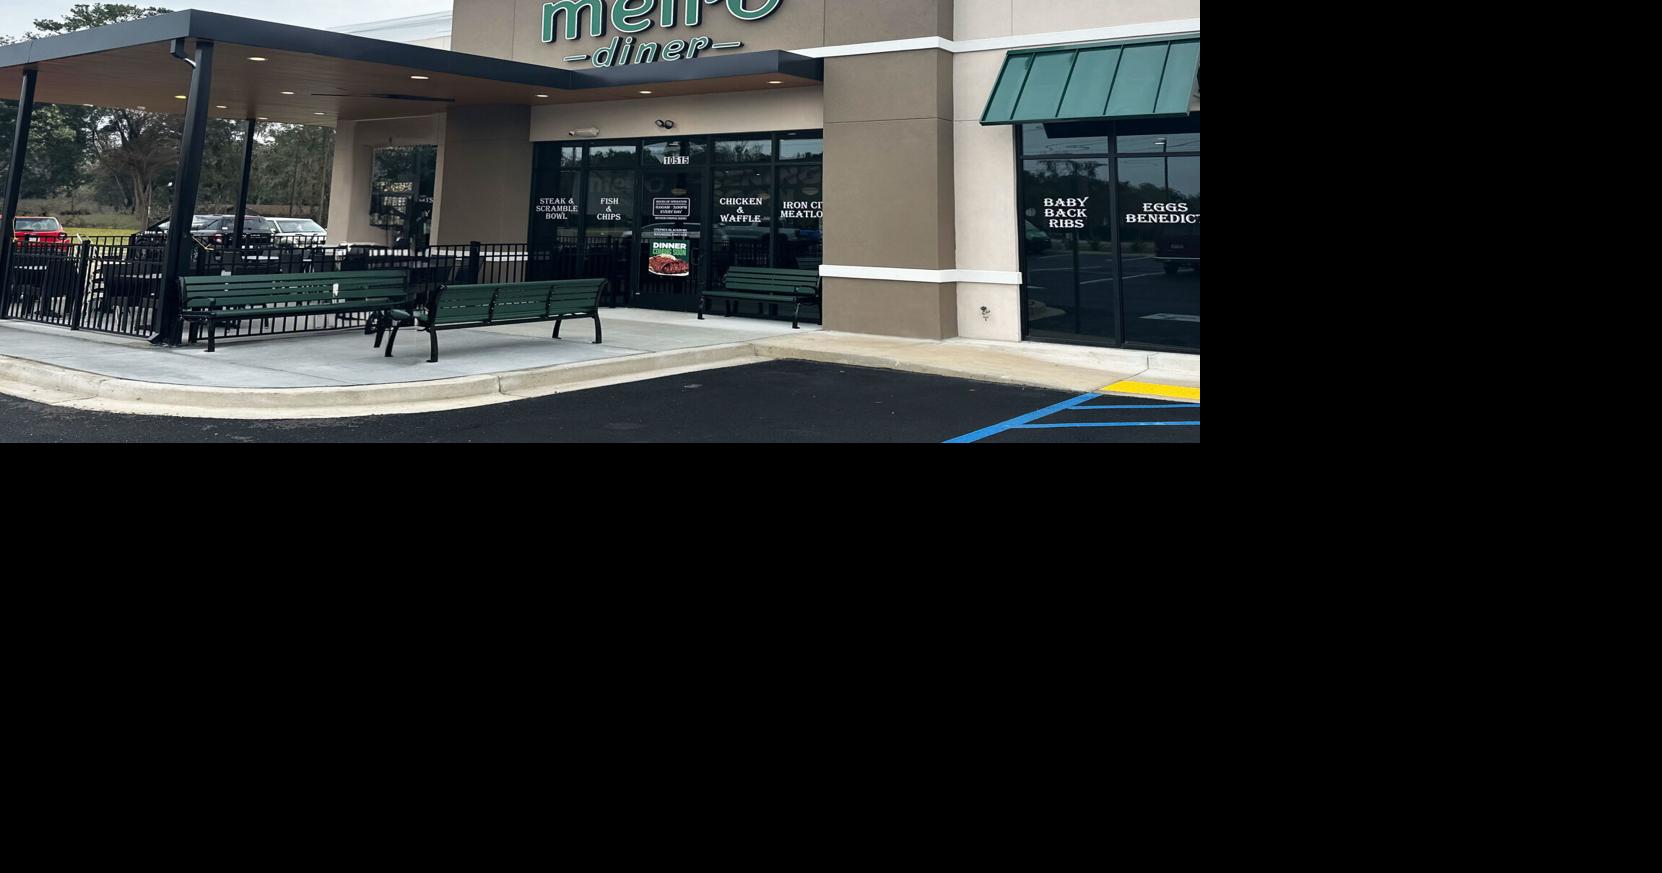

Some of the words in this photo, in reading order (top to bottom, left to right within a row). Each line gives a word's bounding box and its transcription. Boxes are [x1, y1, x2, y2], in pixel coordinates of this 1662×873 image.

[663, 156, 689, 165] 10515
[568, 197, 575, 205] &
[720, 197, 762, 205] CHICKEN
[783, 201, 807, 209] IRON
[1043, 196, 1089, 207] BABY
[736, 206, 744, 214] &
[1142, 202, 1188, 212] EGGS
[1044, 208, 1088, 217] BACK
[720, 213, 761, 222] WAFFLE
[1049, 219, 1084, 228] RIBS
